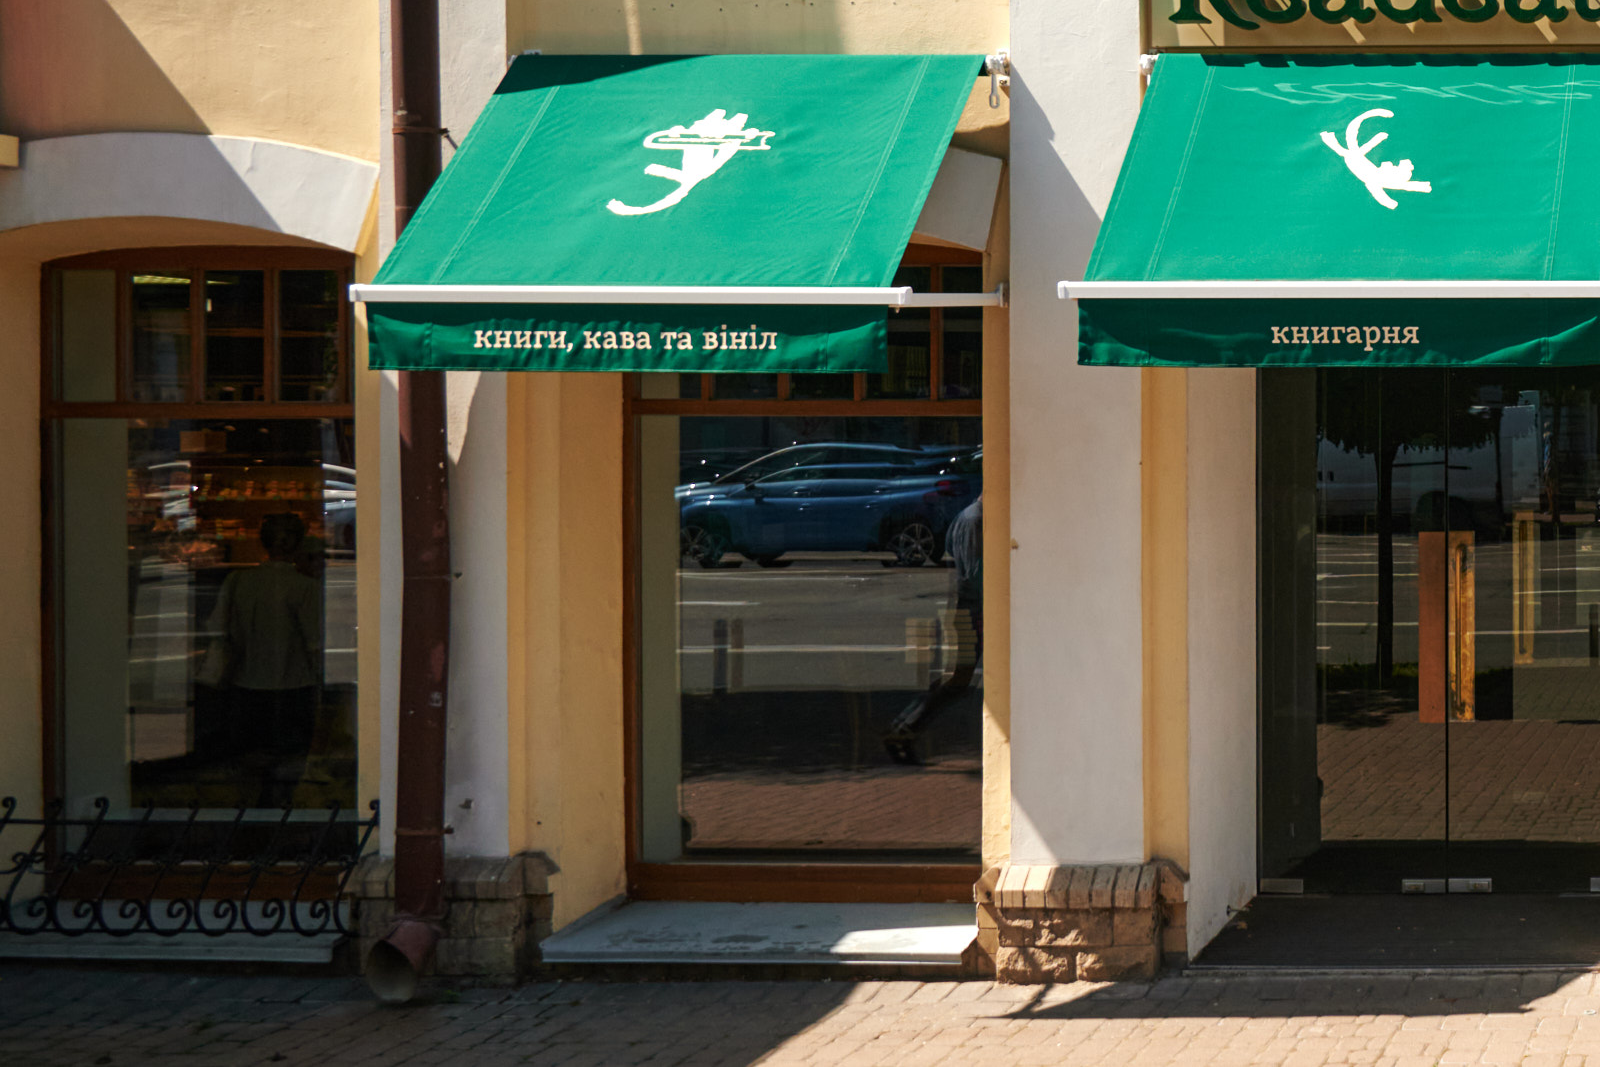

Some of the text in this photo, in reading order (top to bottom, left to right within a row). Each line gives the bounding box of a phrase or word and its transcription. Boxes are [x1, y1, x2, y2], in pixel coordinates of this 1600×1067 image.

[473, 324, 778, 353] книги, кава та вініл
[1270, 326, 1420, 352] книгарня
